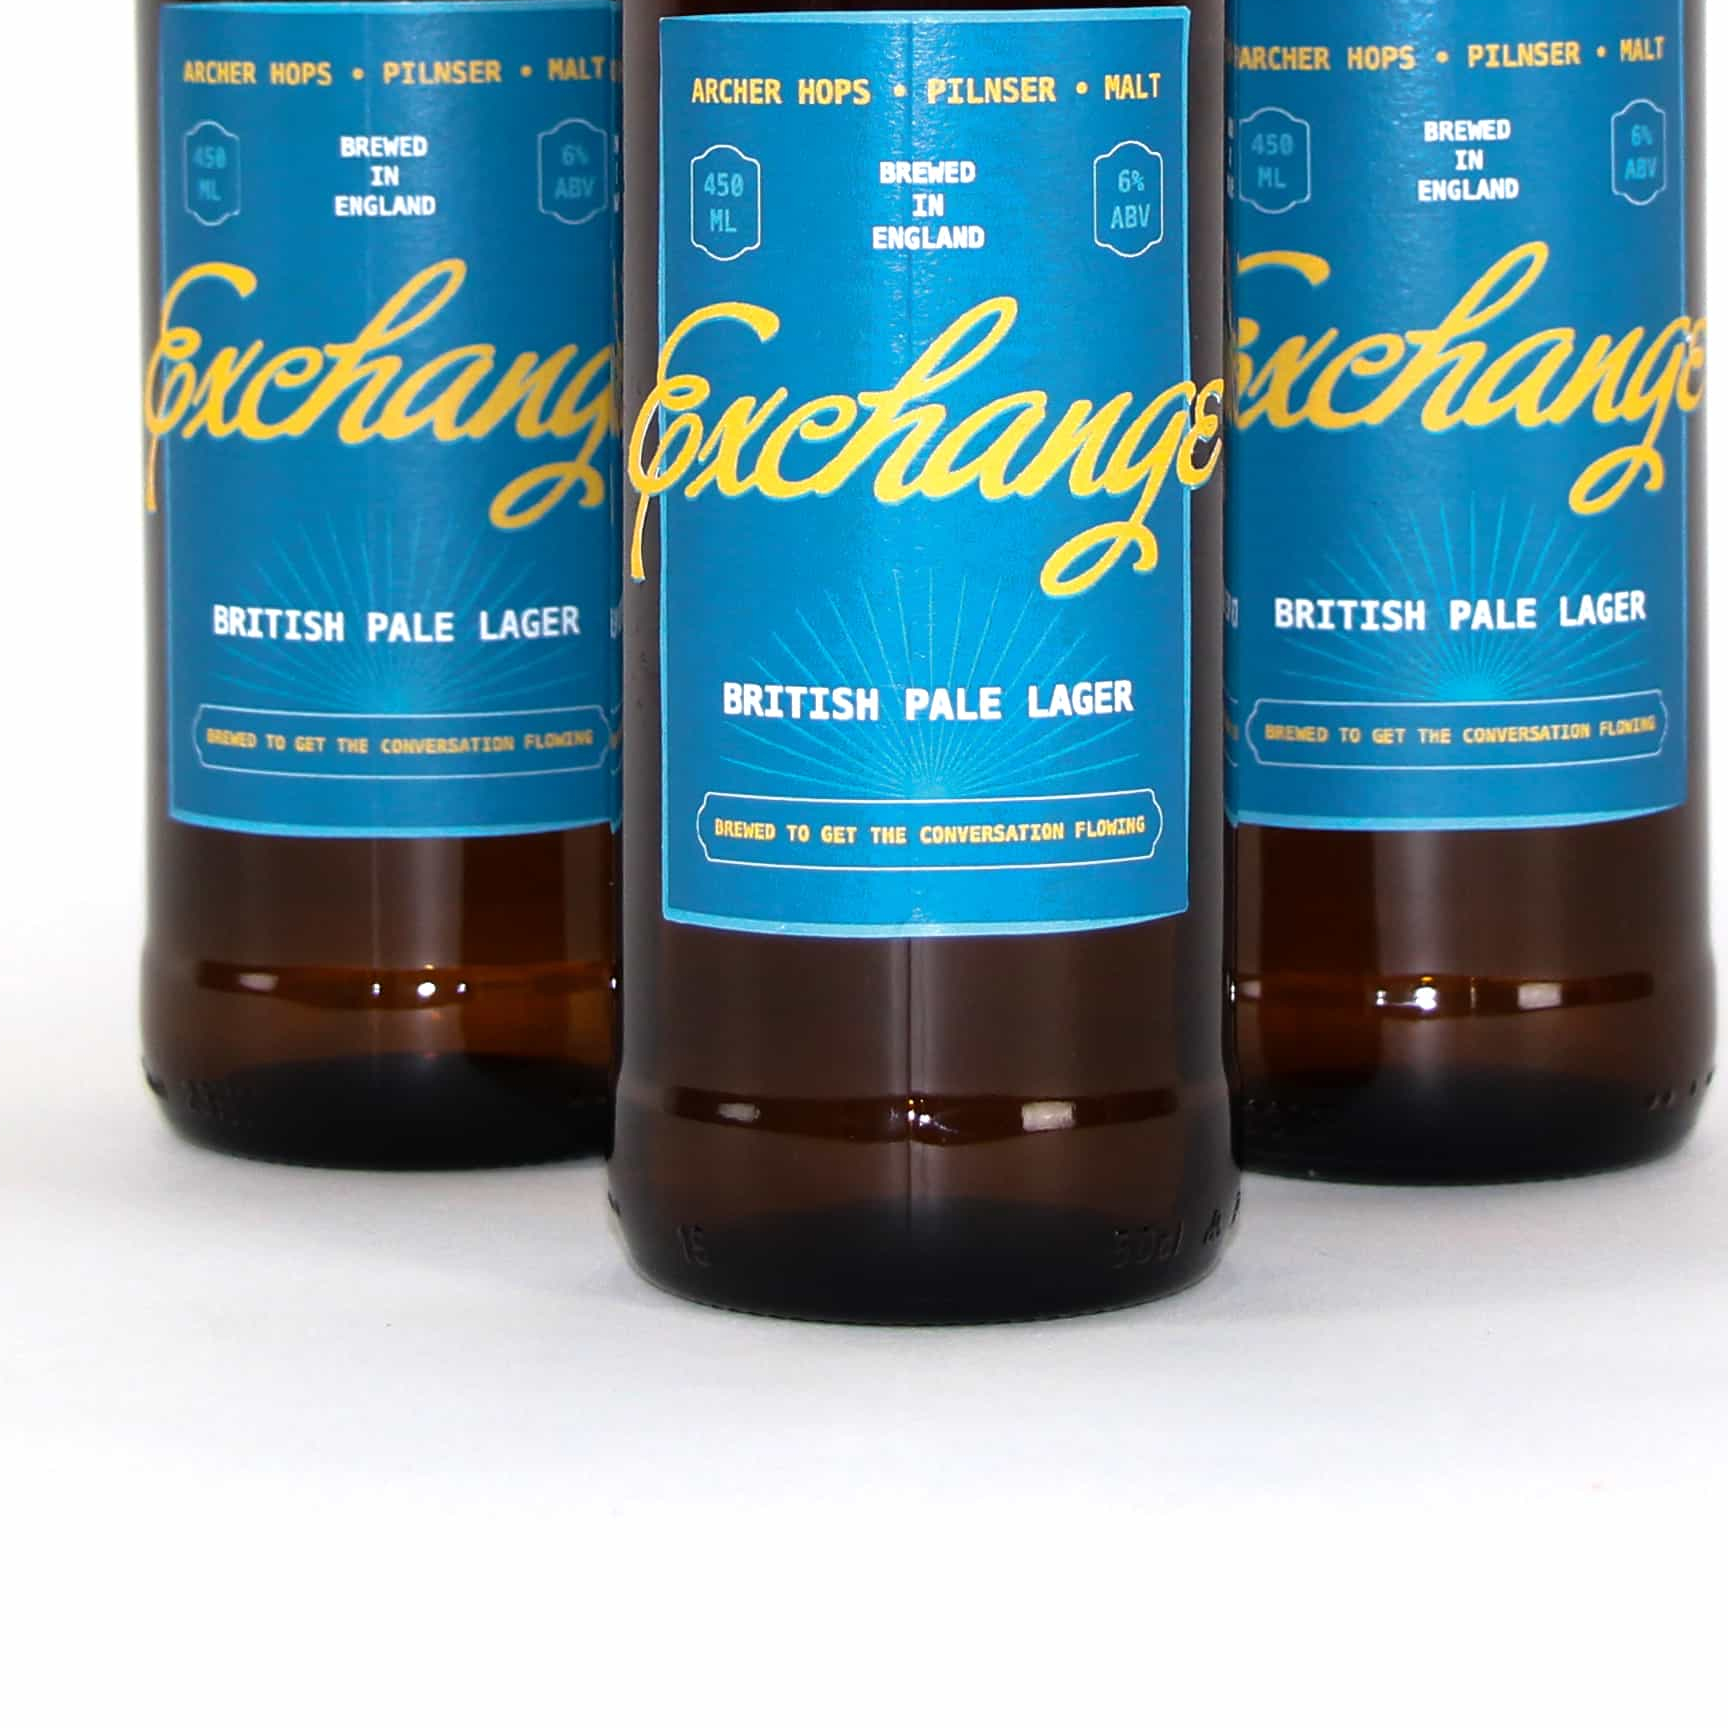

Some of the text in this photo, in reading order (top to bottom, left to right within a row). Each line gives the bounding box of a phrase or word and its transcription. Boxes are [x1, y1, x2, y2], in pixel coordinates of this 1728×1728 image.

[1237, 35, 1665, 71] ARCHER HOPS PILNSER MALT
[183, 56, 604, 86] ARCHER HOPS PILNSER MALT
[691, 72, 1162, 105] ARCHER HOPS PILNSER MALT
[1423, 118, 1512, 143] BREWED
[340, 134, 429, 158] BREWED
[560, 144, 590, 167] 6%
[1252, 133, 1294, 156] 450
[879, 160, 976, 185] BREWED
[1455, 149, 1484, 171] IN
[370, 165, 400, 187] IN
[554, 176, 597, 200] ABV
[703, 173, 744, 197] 450
[1118, 168, 1145, 193] 6%
[1257, 165, 1287, 189] ML
[1417, 177, 1520, 202] ENGLAND
[334, 194, 436, 217] ENGLAND
[912, 193, 945, 218] IN
[1110, 203, 1151, 229] ABV
[710, 208, 738, 233] ML
[872, 225, 985, 251] ENGLAND
[144, 258, 612, 530] Exchang
[628, 296, 1224, 597] Exchange
[213, 604, 579, 643] BRITISH PALE LAGER
[1275, 590, 1647, 632] BRITISH PALE LAGER
[723, 679, 1134, 721] BRITISH PALE LAGER
[206, 728, 593, 754] BREWED TO GET THE CONVERSATION FLOWING
[1264, 716, 1657, 745] BREWED TO GET THE CONVERSATION FLOWING
[714, 816, 1146, 844] BREWED TO GET THE CONVERSATION FLOWING
